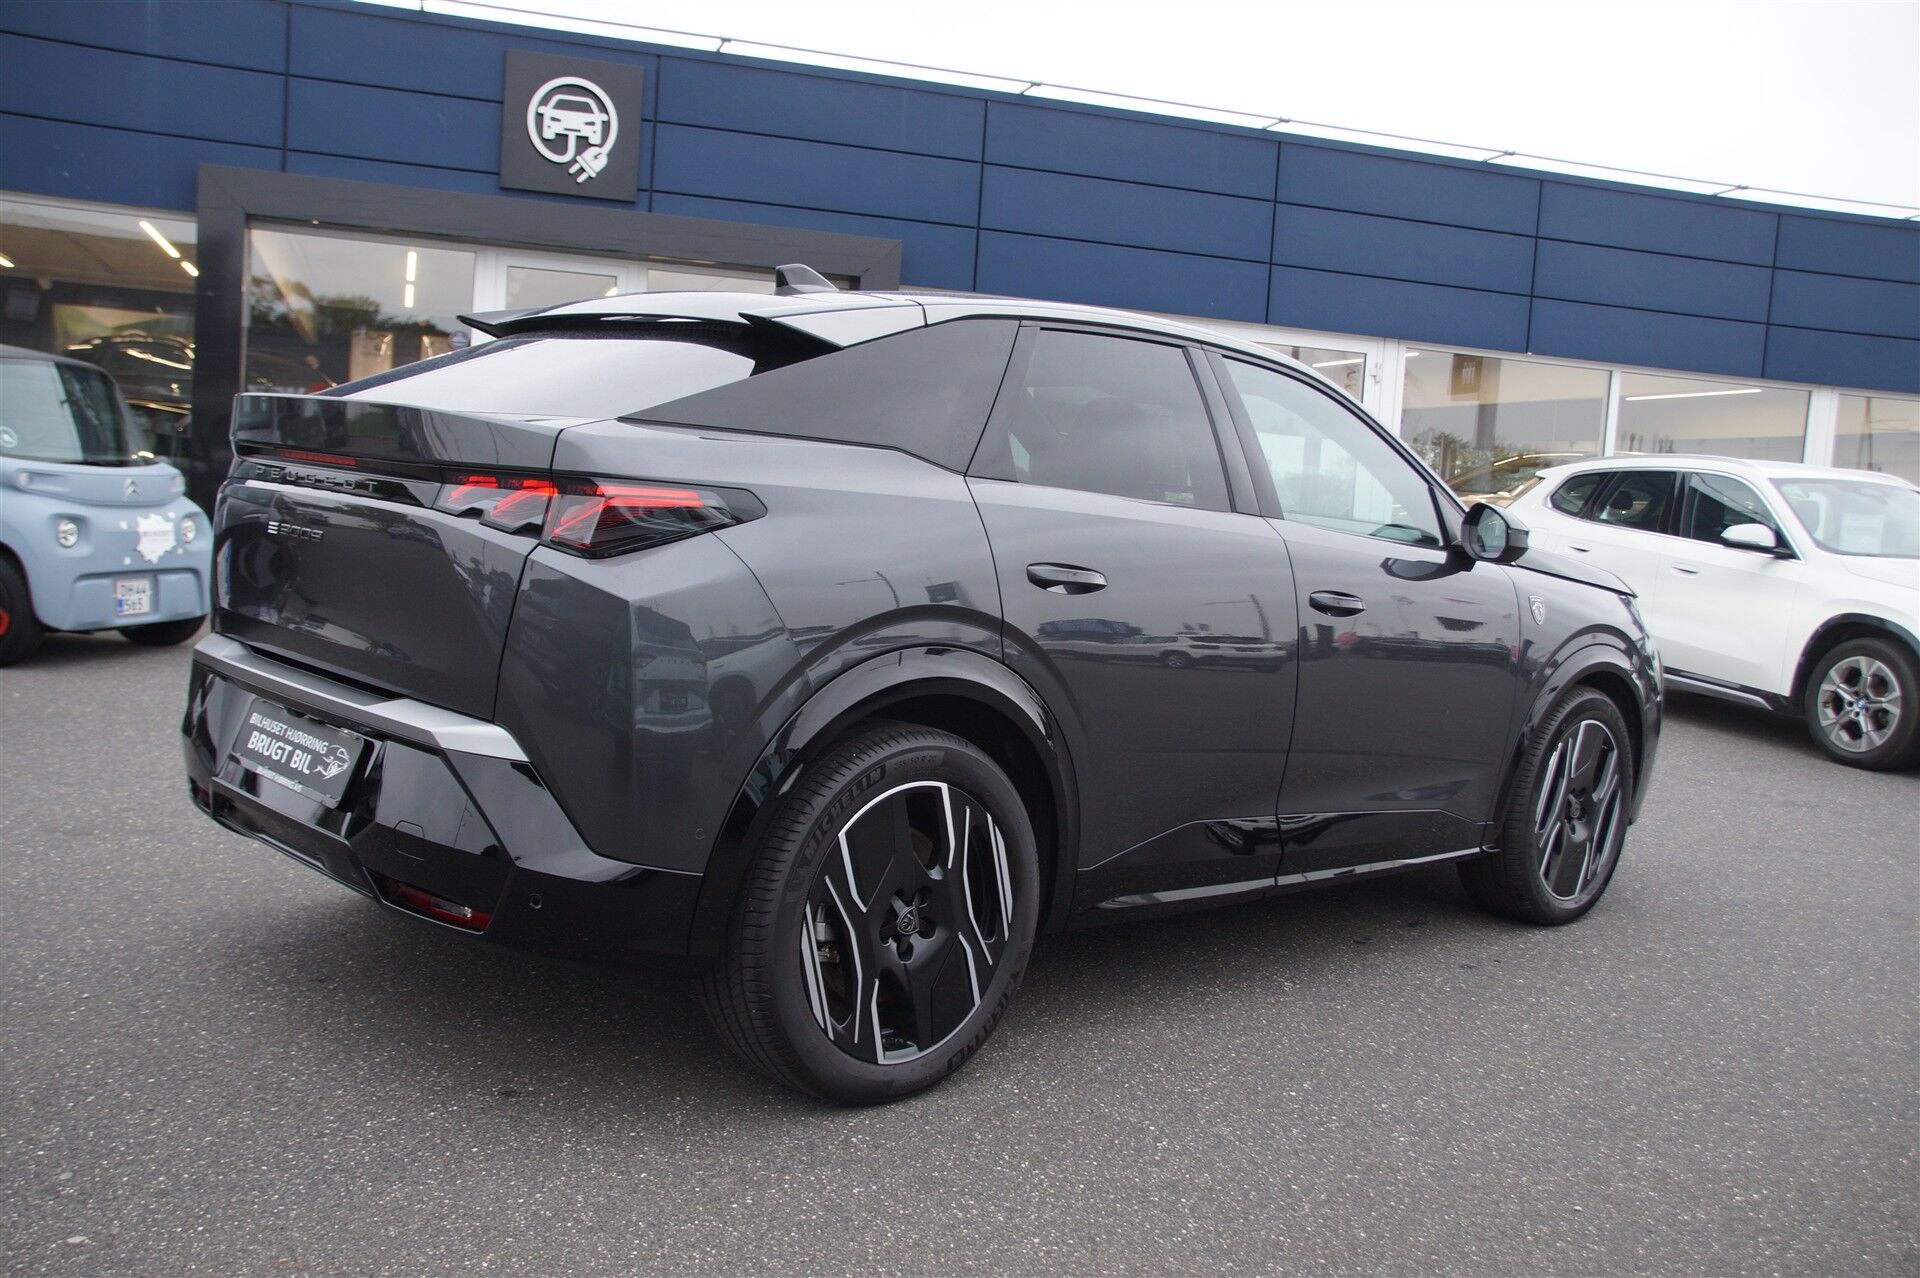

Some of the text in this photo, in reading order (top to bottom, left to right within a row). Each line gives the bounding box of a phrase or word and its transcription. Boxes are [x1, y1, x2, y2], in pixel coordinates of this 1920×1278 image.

[255, 464, 378, 492] PEUGEOT
[247, 730, 312, 775] BRUGT BIL
[249, 712, 329, 754] BILHUSET HJØRRING
[803, 764, 883, 861] MICHELIN
